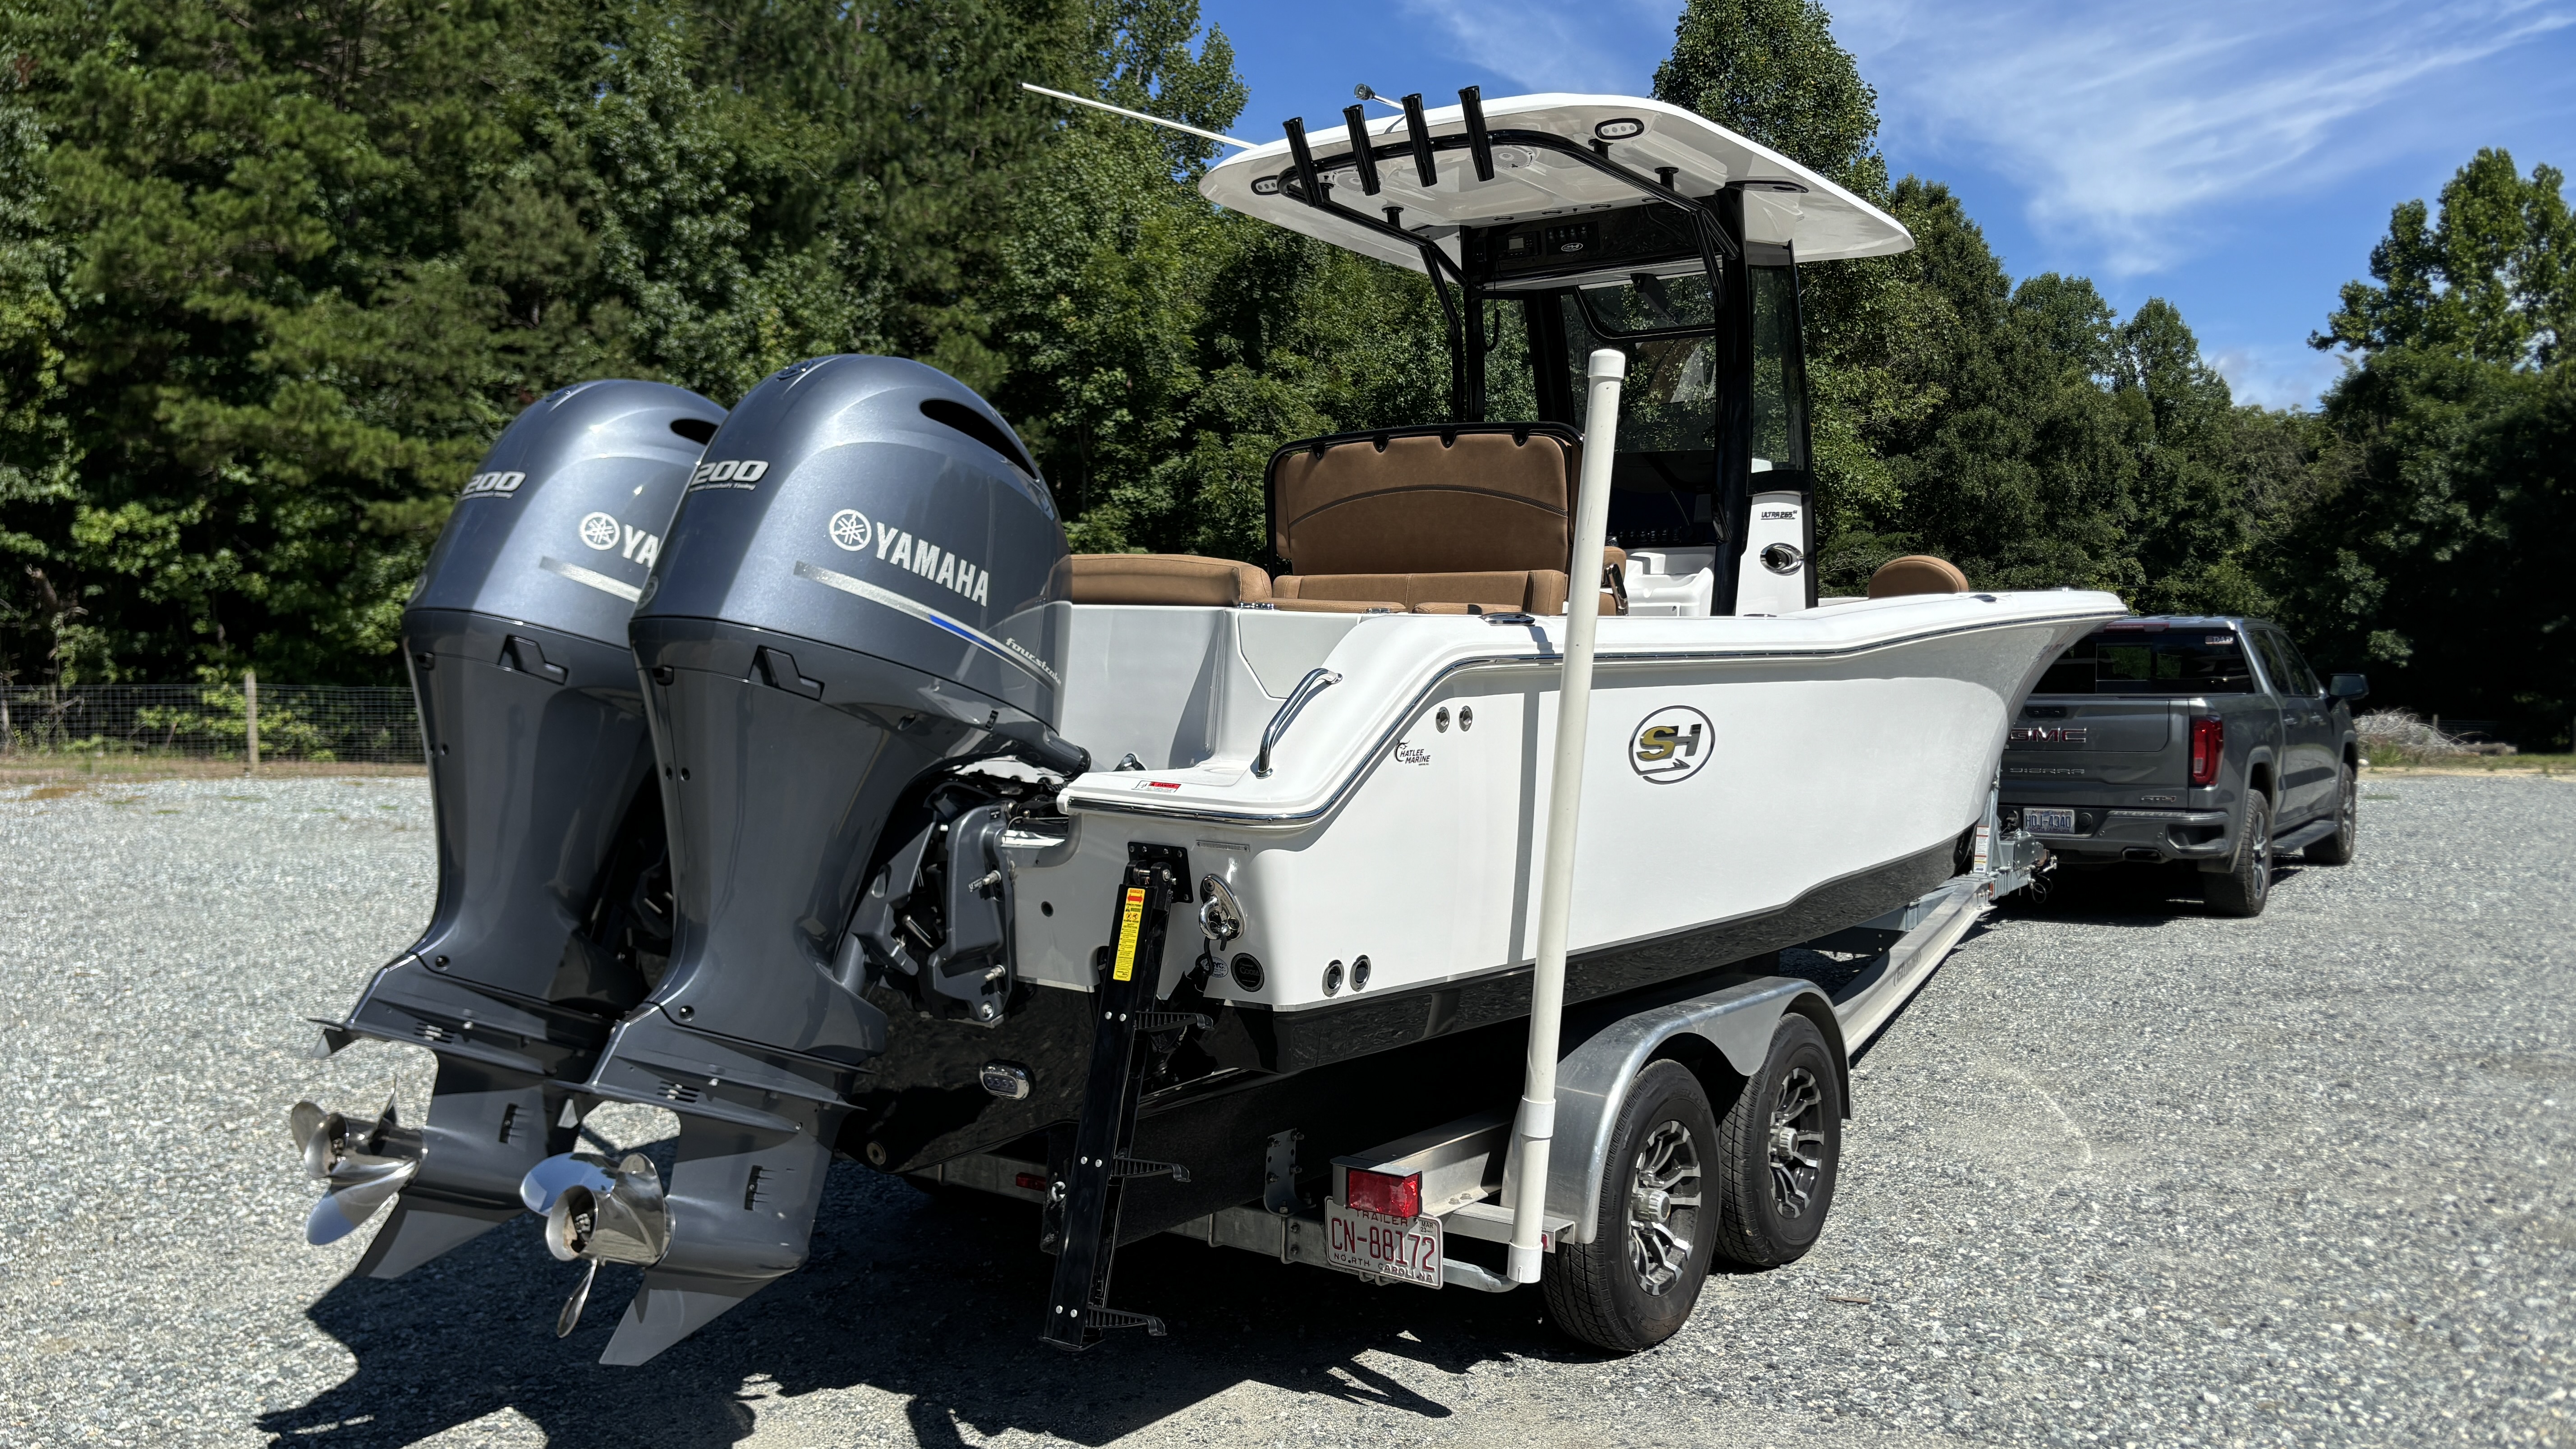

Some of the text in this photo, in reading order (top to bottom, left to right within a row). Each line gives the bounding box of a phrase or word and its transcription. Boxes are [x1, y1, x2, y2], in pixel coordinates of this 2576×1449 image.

[462, 471, 526, 495] 200
[691, 460, 769, 486] 200
[876, 522, 989, 607] YAMAHA
[1636, 723, 1702, 762] SH
[2008, 727, 2087, 743] GMC
[1405, 755, 1431, 764] MARINE
[1356, 1209, 1408, 1227] TRAILER
[1332, 1218, 1435, 1272] CN-88172
[1334, 1252, 1434, 1283] NORTH CAROLINA
